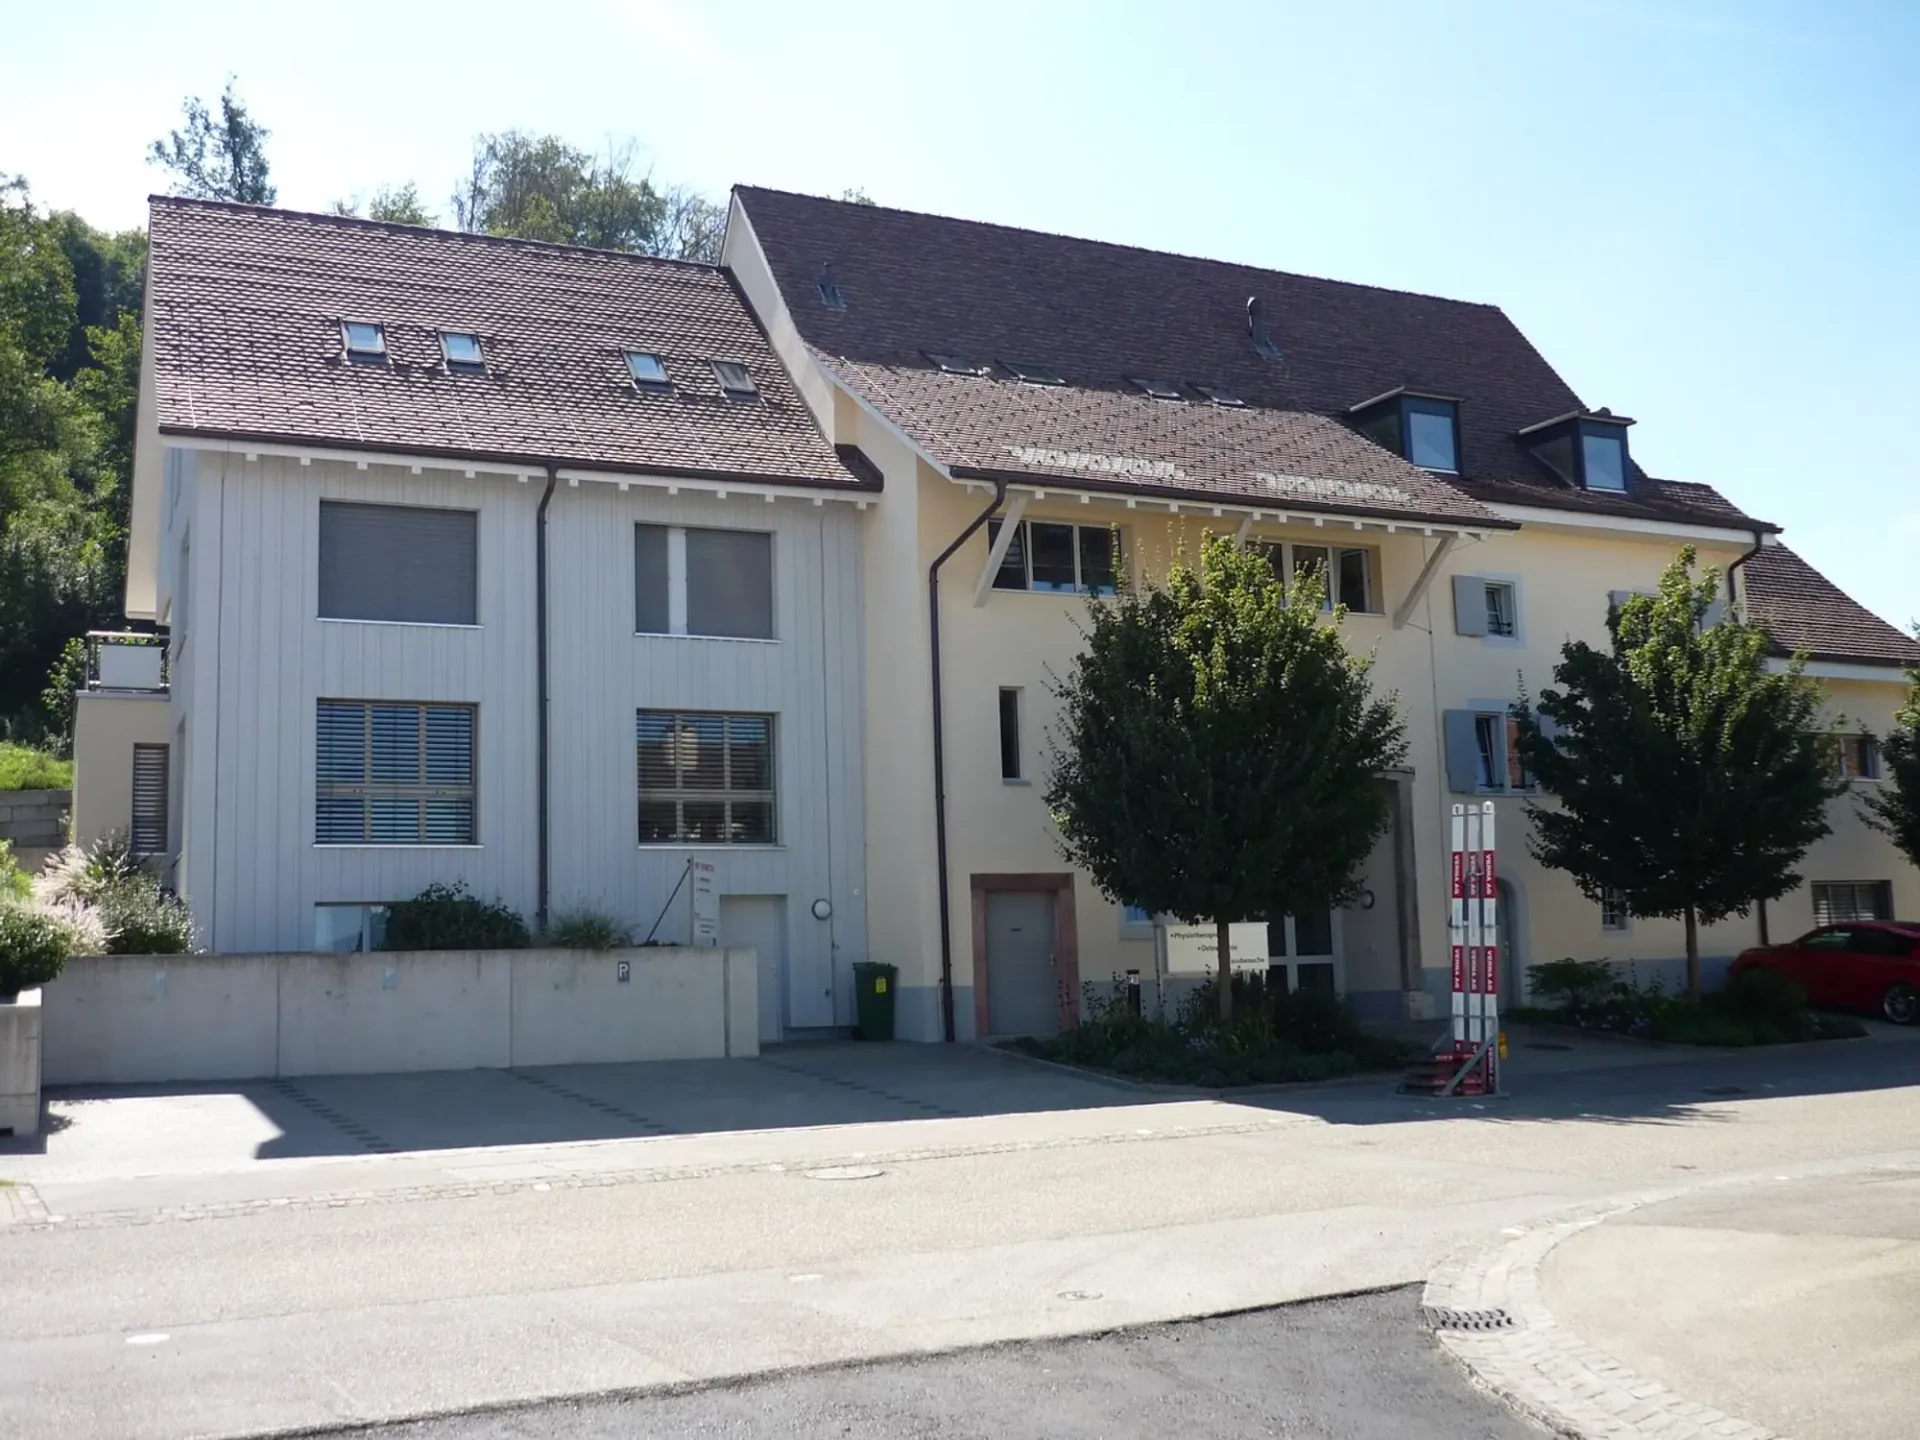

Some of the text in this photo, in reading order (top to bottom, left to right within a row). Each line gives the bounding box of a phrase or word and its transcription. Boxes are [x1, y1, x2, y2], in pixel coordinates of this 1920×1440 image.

[1454, 883, 1460, 895] AG
[1486, 883, 1492, 895] AG
[619, 963, 629, 979] P
[1454, 977, 1460, 989] AG
[1471, 978, 1477, 990] AG
[1487, 979, 1493, 991] AG
